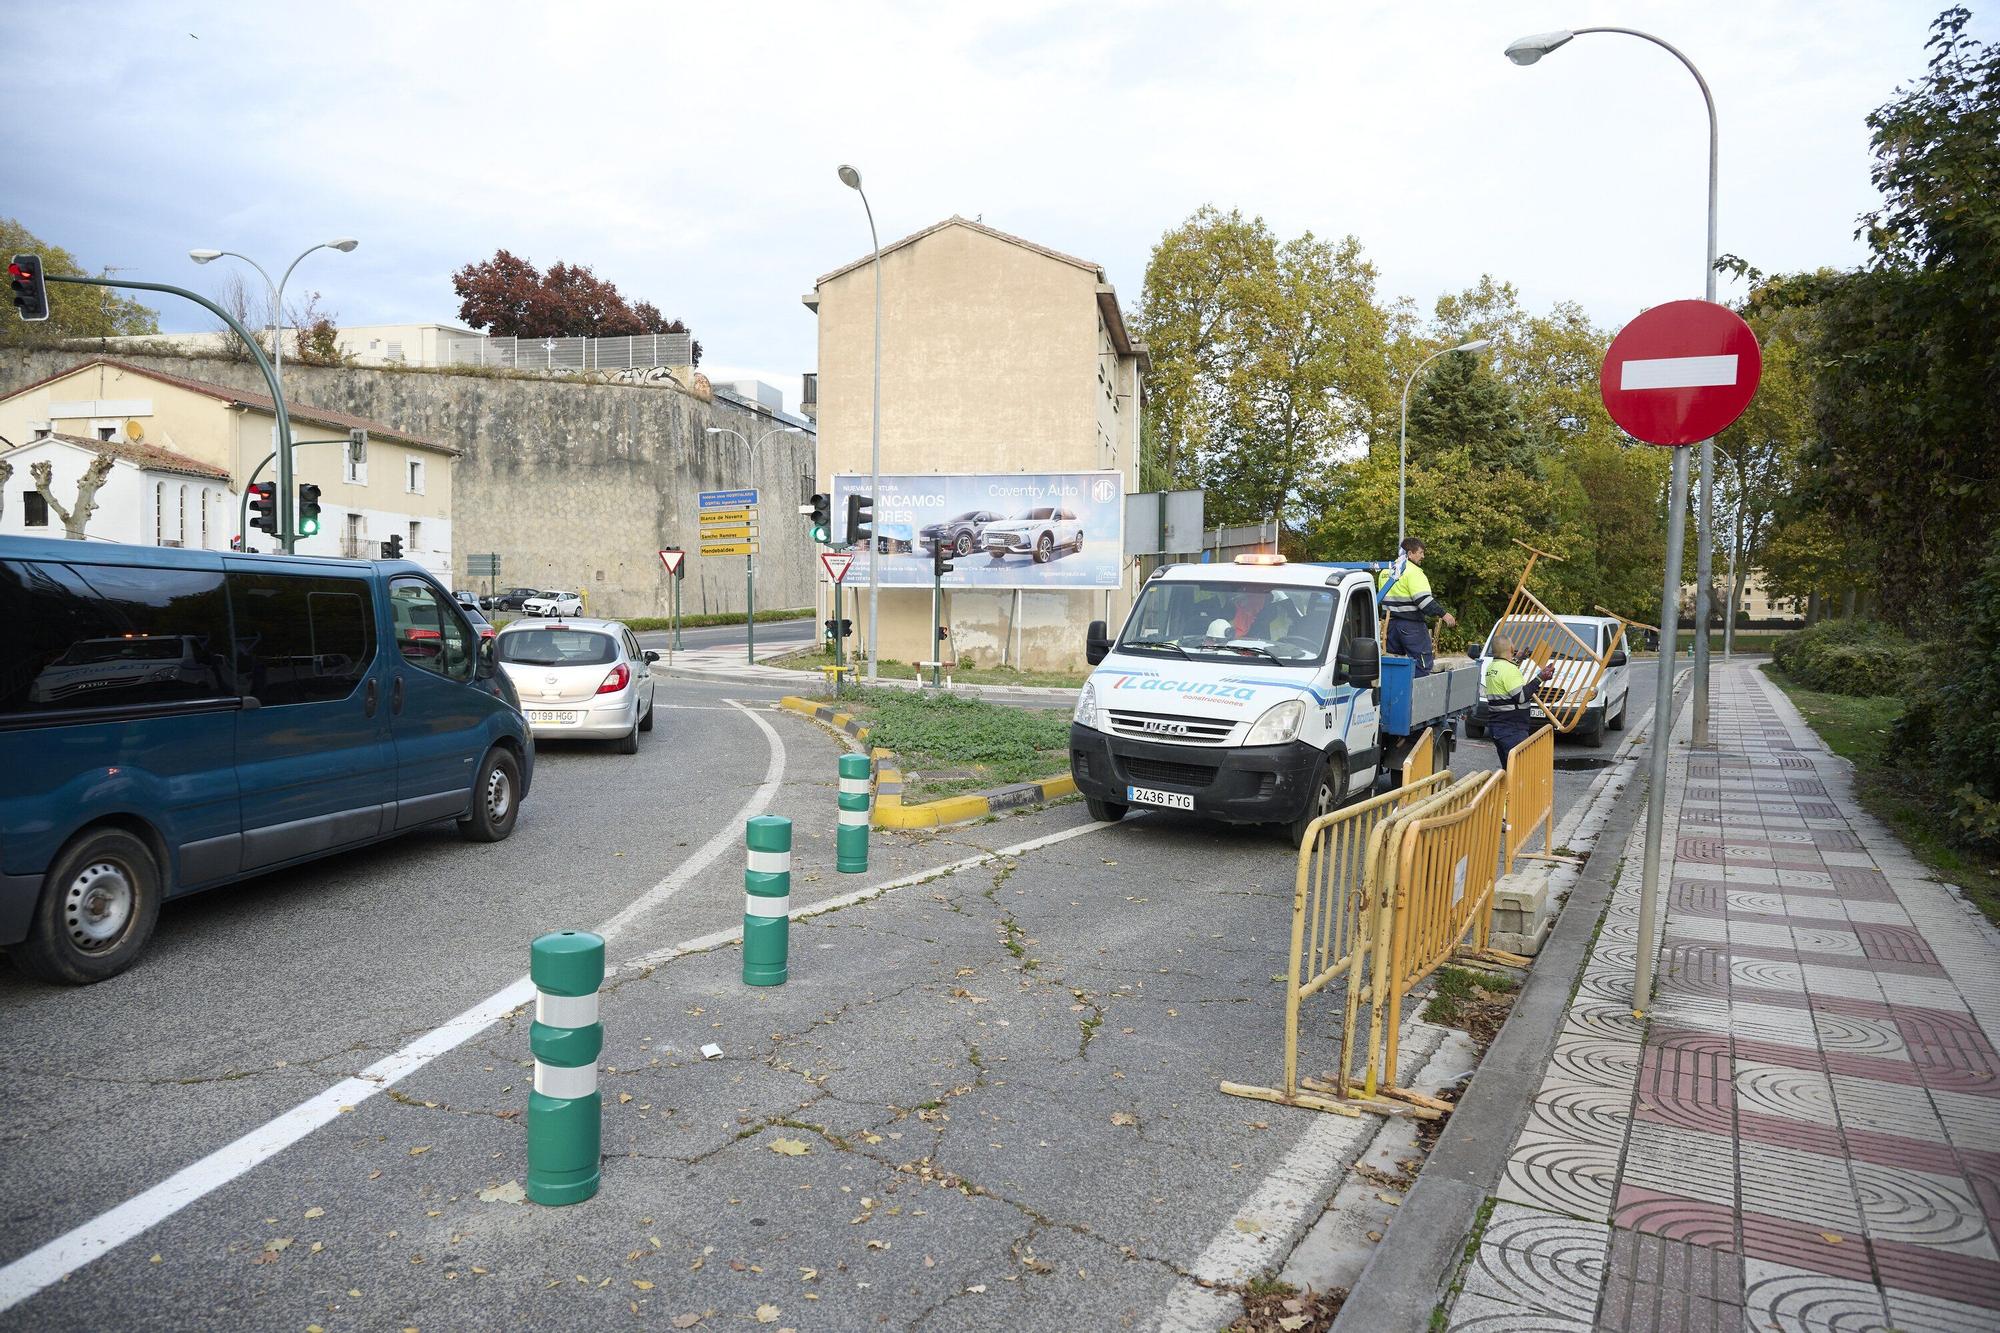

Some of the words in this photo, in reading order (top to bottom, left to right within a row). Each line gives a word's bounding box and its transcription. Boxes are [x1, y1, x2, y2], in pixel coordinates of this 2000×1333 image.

[988, 484, 1045, 499] Coventry
[1048, 484, 1078, 497] Auto
[1093, 480, 1115, 503] MG
[1182, 693, 1245, 707] construcciones
[531, 711, 553, 720] 0199
[556, 711, 573, 720] HGG
[1325, 712, 1333, 730] 09
[1143, 721, 1188, 736] IVECO
[1135, 788, 1165, 804] 2436
[1167, 794, 1191, 809] FYG
